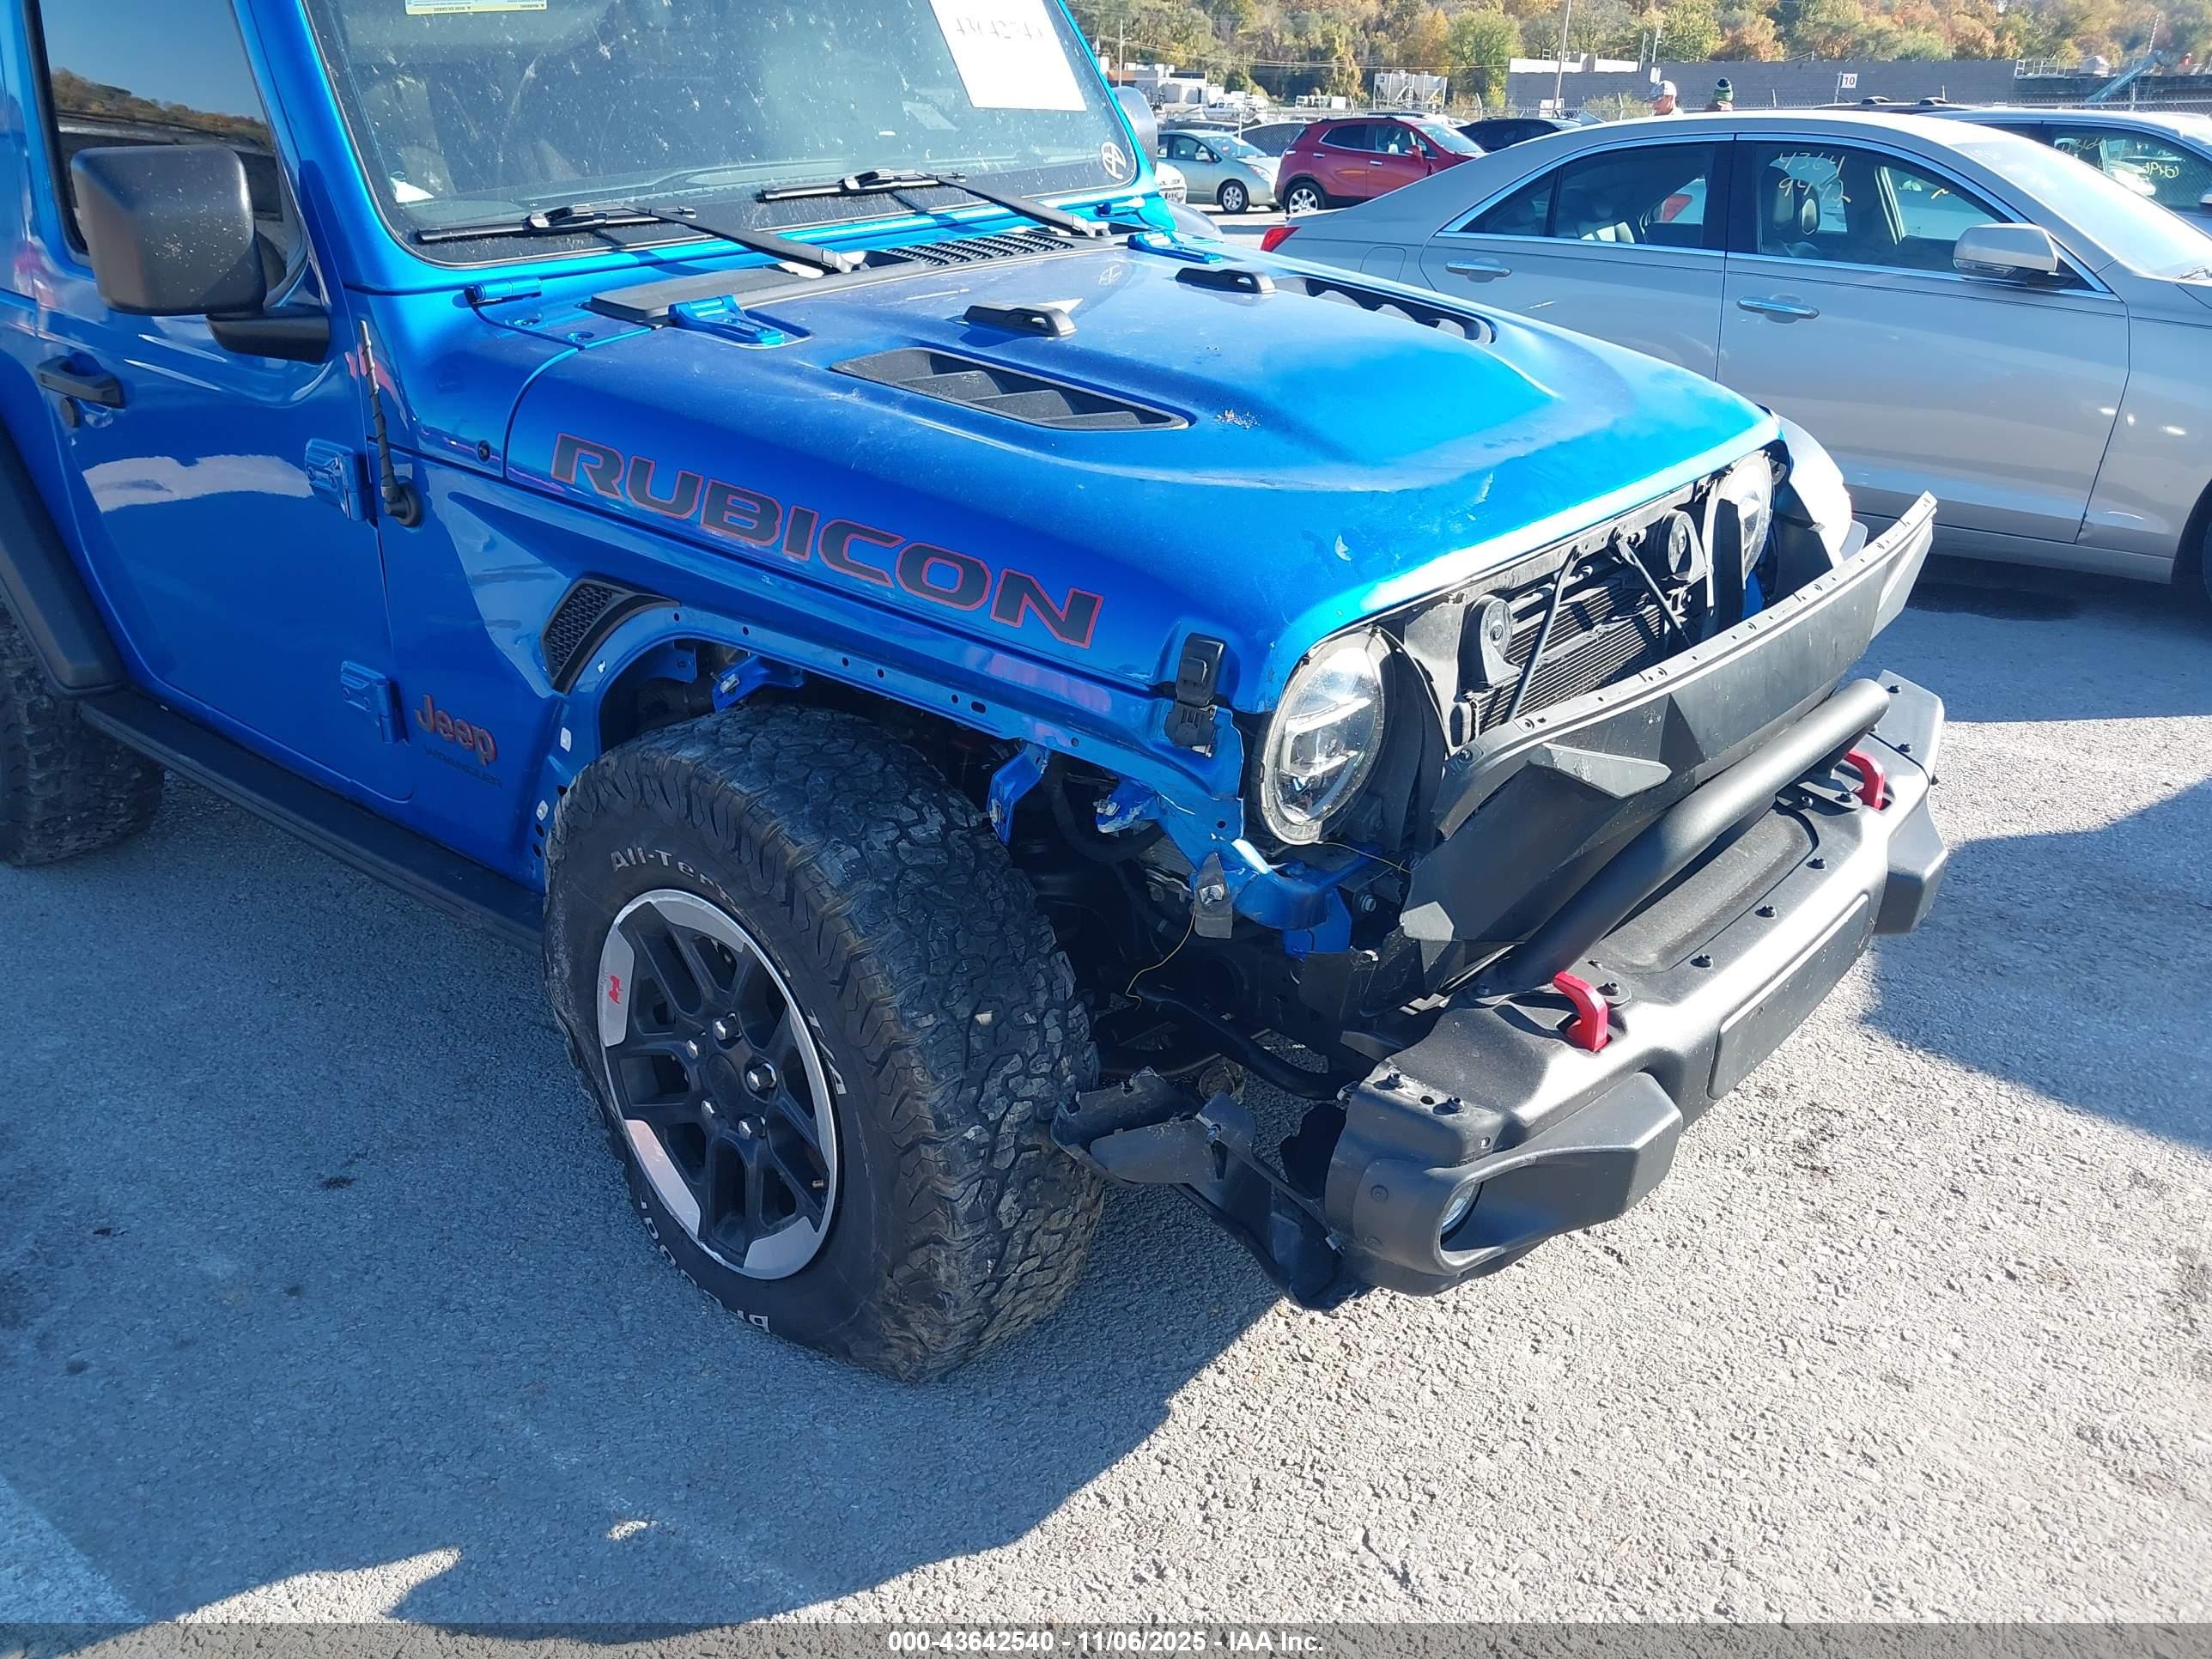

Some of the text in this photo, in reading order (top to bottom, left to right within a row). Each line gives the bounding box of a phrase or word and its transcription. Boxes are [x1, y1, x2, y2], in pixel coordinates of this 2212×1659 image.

[1844, 76, 1855, 85] 10
[1778, 151, 1845, 176] 4364
[1778, 177, 1851, 204] 9442
[550, 432, 1104, 649] RUBICON
[414, 692, 498, 767] Jeep
[807, 1007, 848, 1095] T/A
